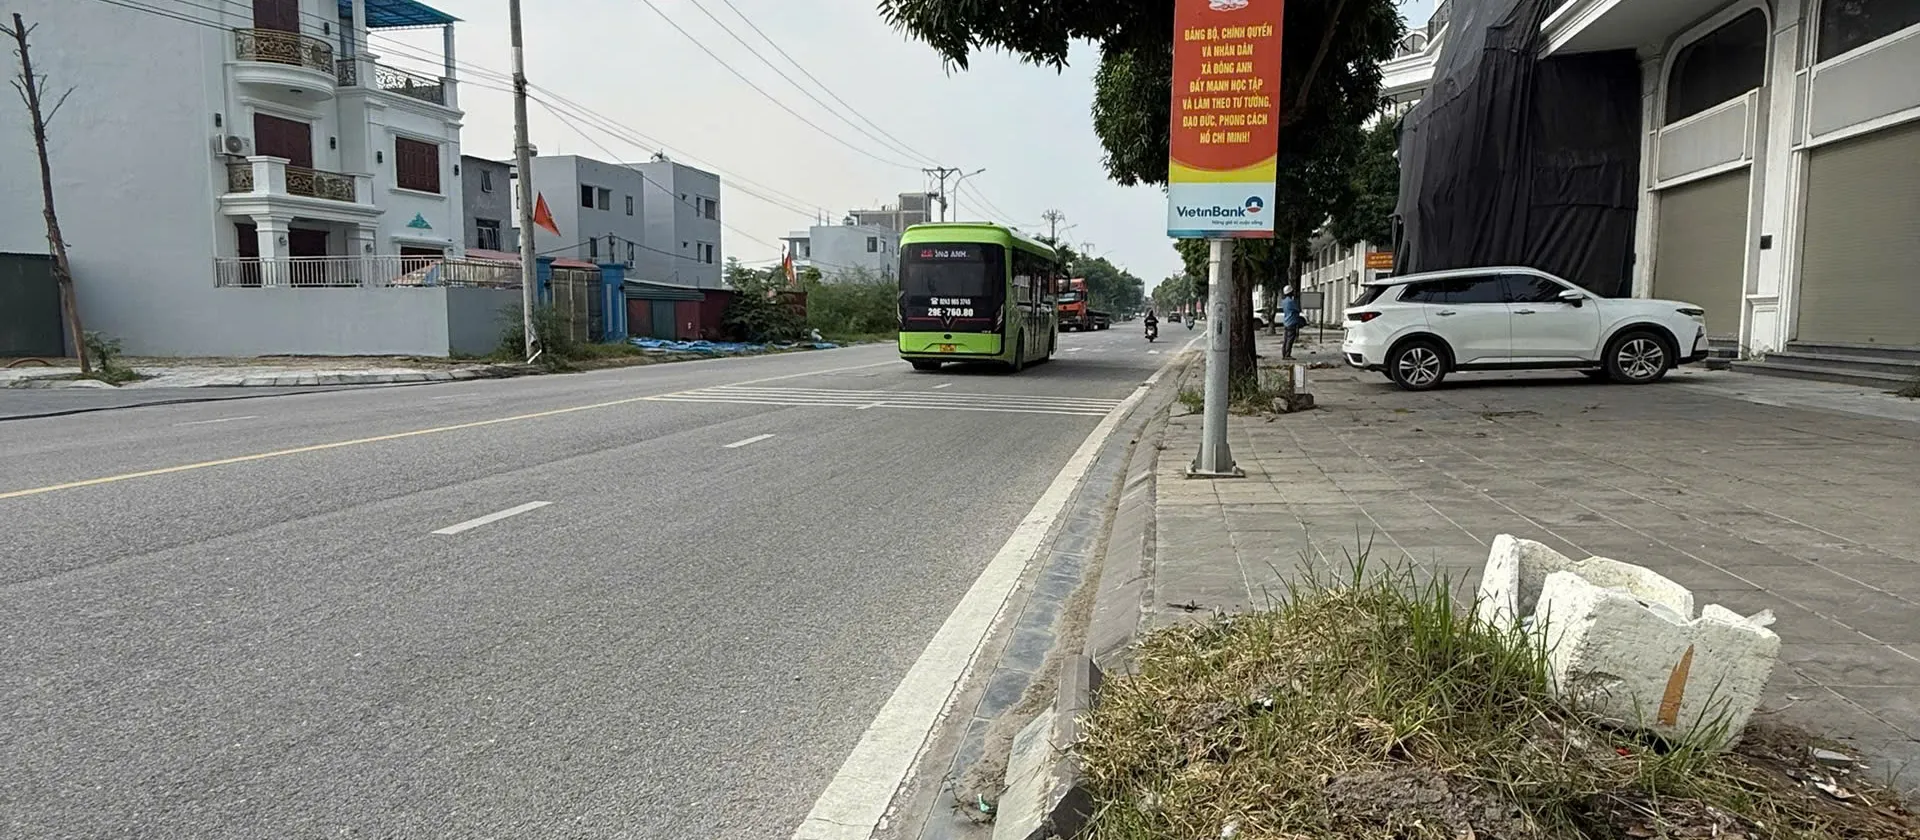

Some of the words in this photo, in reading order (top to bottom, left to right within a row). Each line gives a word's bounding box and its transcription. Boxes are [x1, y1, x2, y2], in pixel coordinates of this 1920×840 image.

[1213, 42, 1235, 57] NHÂN
[1237, 42, 1254, 56] DÂN
[1213, 60, 1235, 74] ĐÔNG
[1236, 61, 1253, 73] ANH
[1206, 79, 1229, 94] MẠNH
[1230, 79, 1247, 93] HỌC
[1194, 96, 1210, 110] LÀM
[1212, 97, 1231, 109] THEO
[1182, 115, 1198, 129] ĐẠO
[1219, 114, 1246, 126] PHONG
[1246, 111, 1268, 125] CÁCH
[1176, 206, 1246, 218] VietinBank
